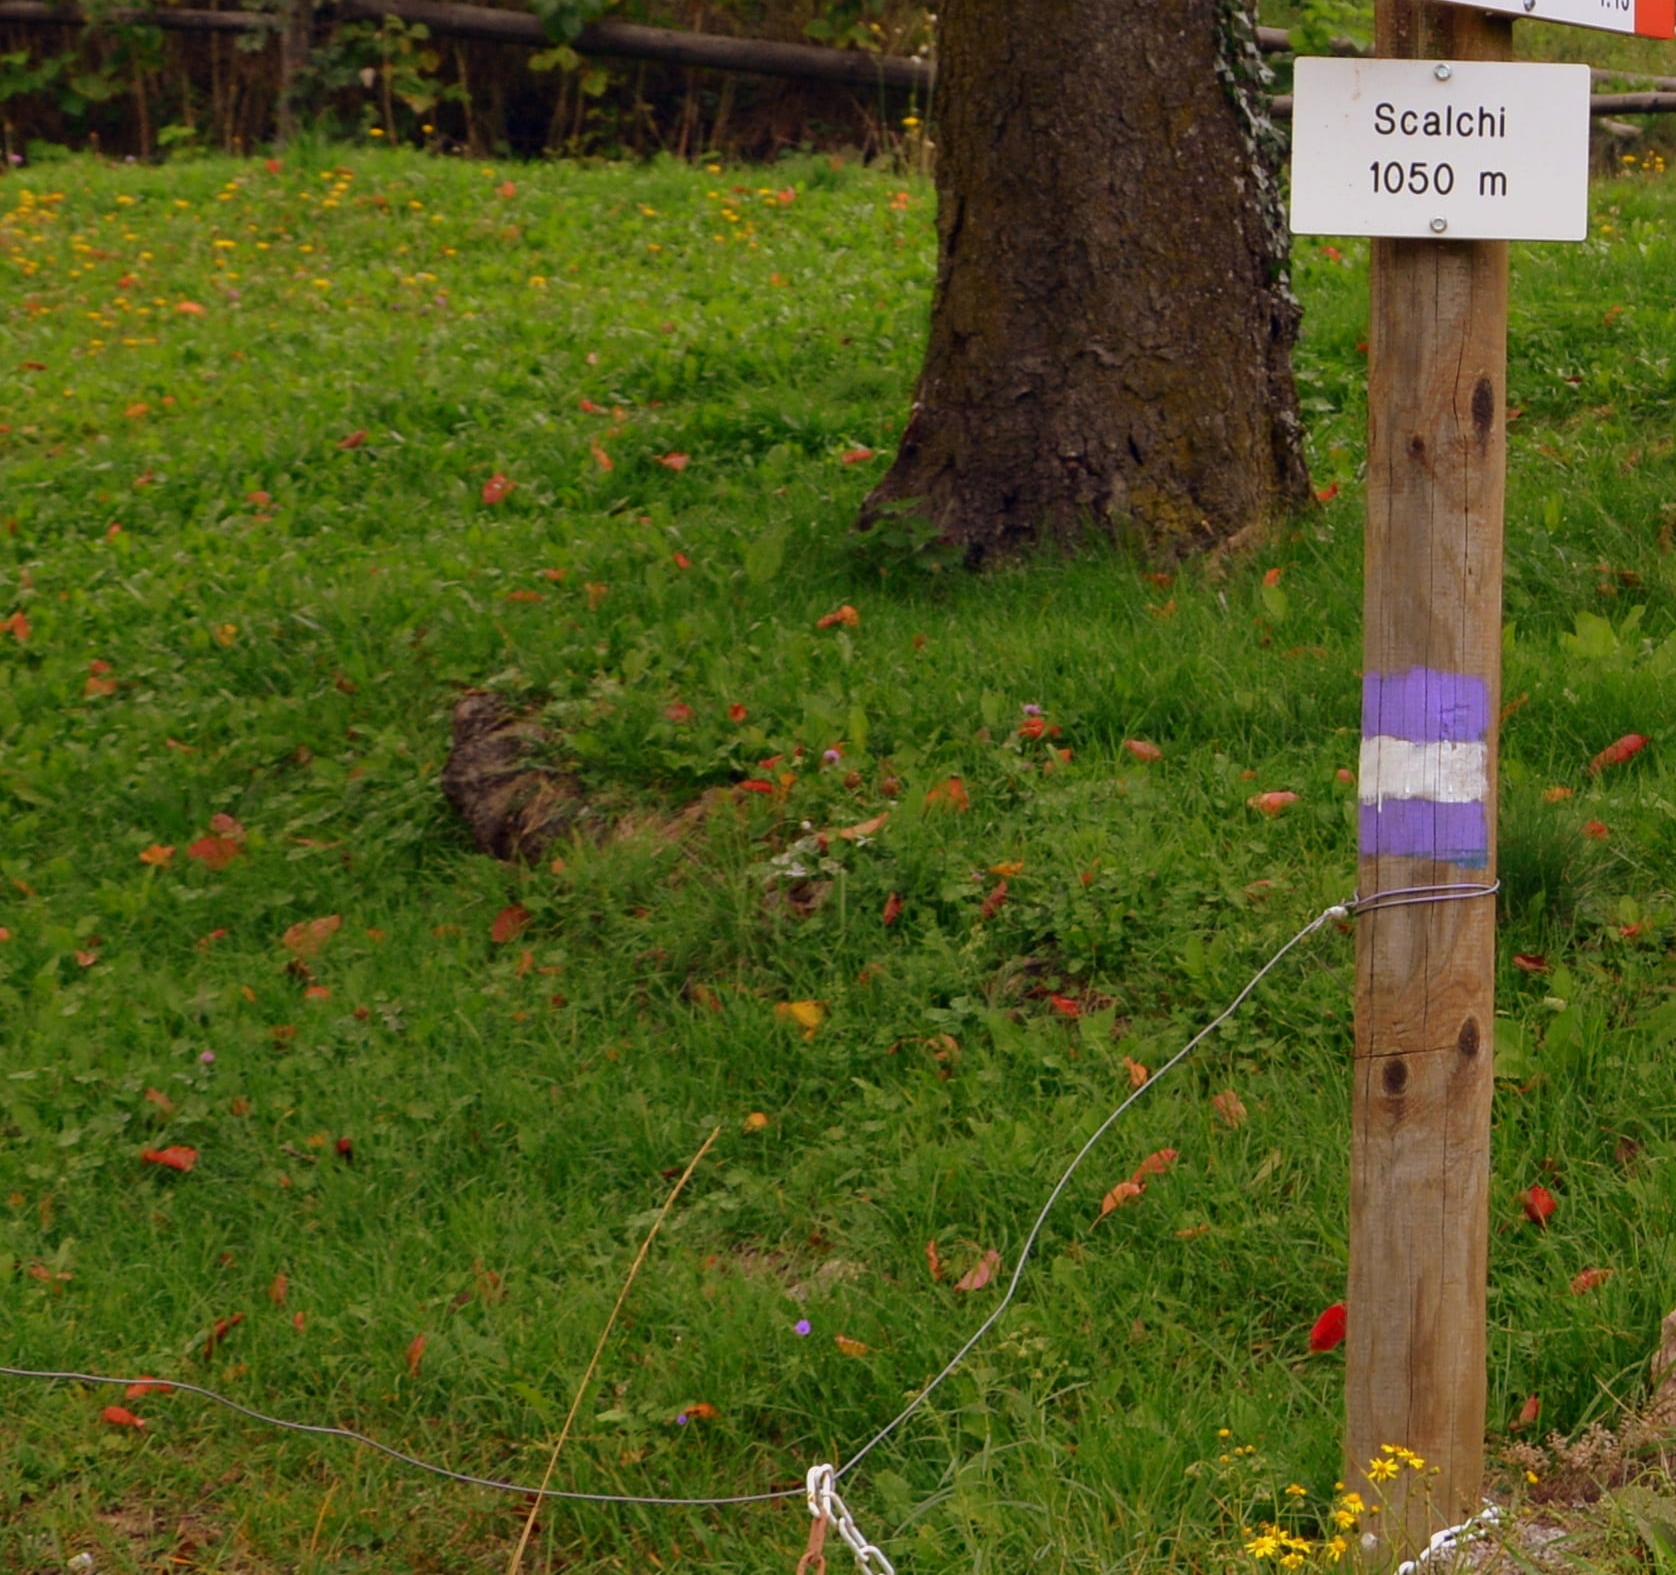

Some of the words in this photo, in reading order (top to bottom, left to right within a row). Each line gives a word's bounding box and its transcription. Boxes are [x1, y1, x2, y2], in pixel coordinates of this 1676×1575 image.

[1374, 102, 1507, 138] Scalchi
[1369, 161, 1455, 196] 1050
[1479, 170, 1508, 197] m
